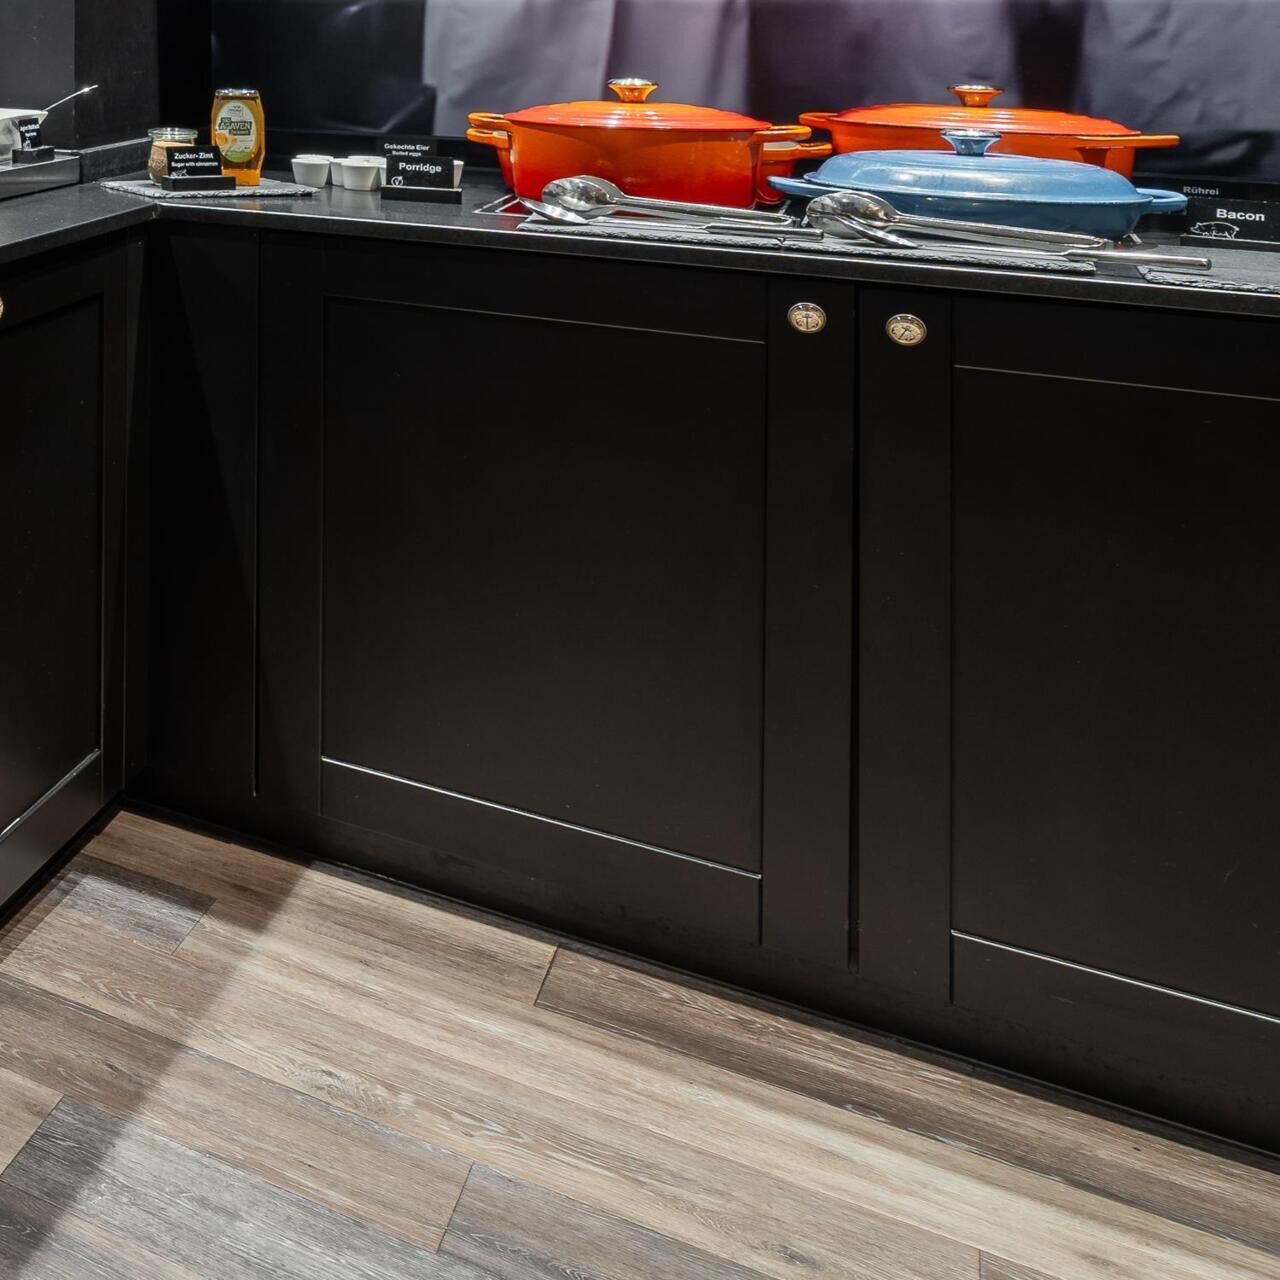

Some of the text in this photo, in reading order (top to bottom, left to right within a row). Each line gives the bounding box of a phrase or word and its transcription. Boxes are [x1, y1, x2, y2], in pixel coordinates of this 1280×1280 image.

[399, 162, 442, 174] Porridge
[1183, 186, 1219, 195] Rührei
[1216, 208, 1265, 221] Bacon
